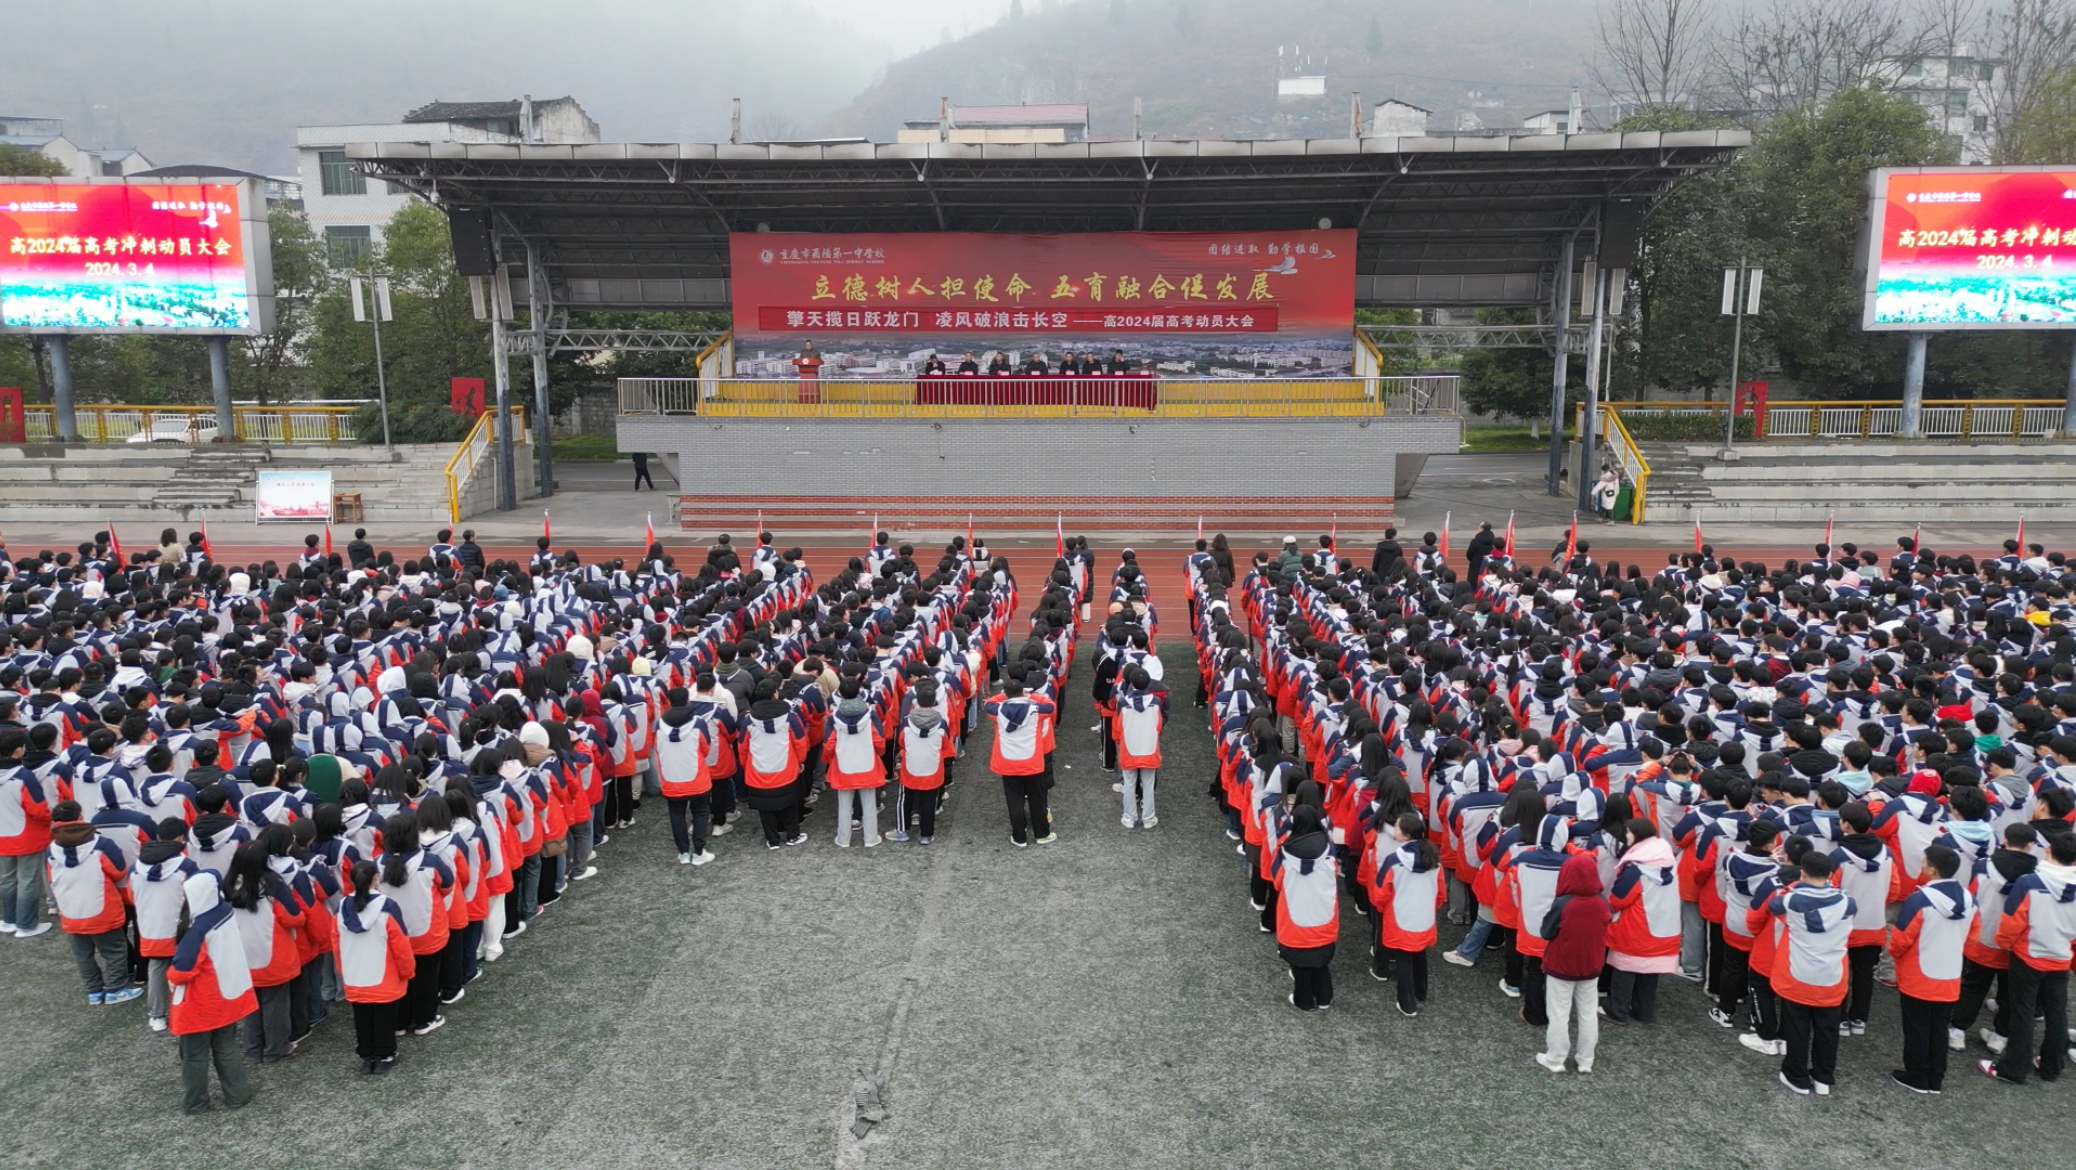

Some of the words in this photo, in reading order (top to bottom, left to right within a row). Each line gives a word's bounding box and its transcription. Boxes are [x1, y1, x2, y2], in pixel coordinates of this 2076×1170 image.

[10, 236, 232, 256] 高2024届高考冲刺动员大会
[811, 272, 1032, 302] 立德树人担使命
[1050, 271, 1275, 302] 五育融合促发展
[787, 310, 919, 328] 擎天揽日跃龙门
[936, 310, 1067, 328] 凌风破浪击长空
